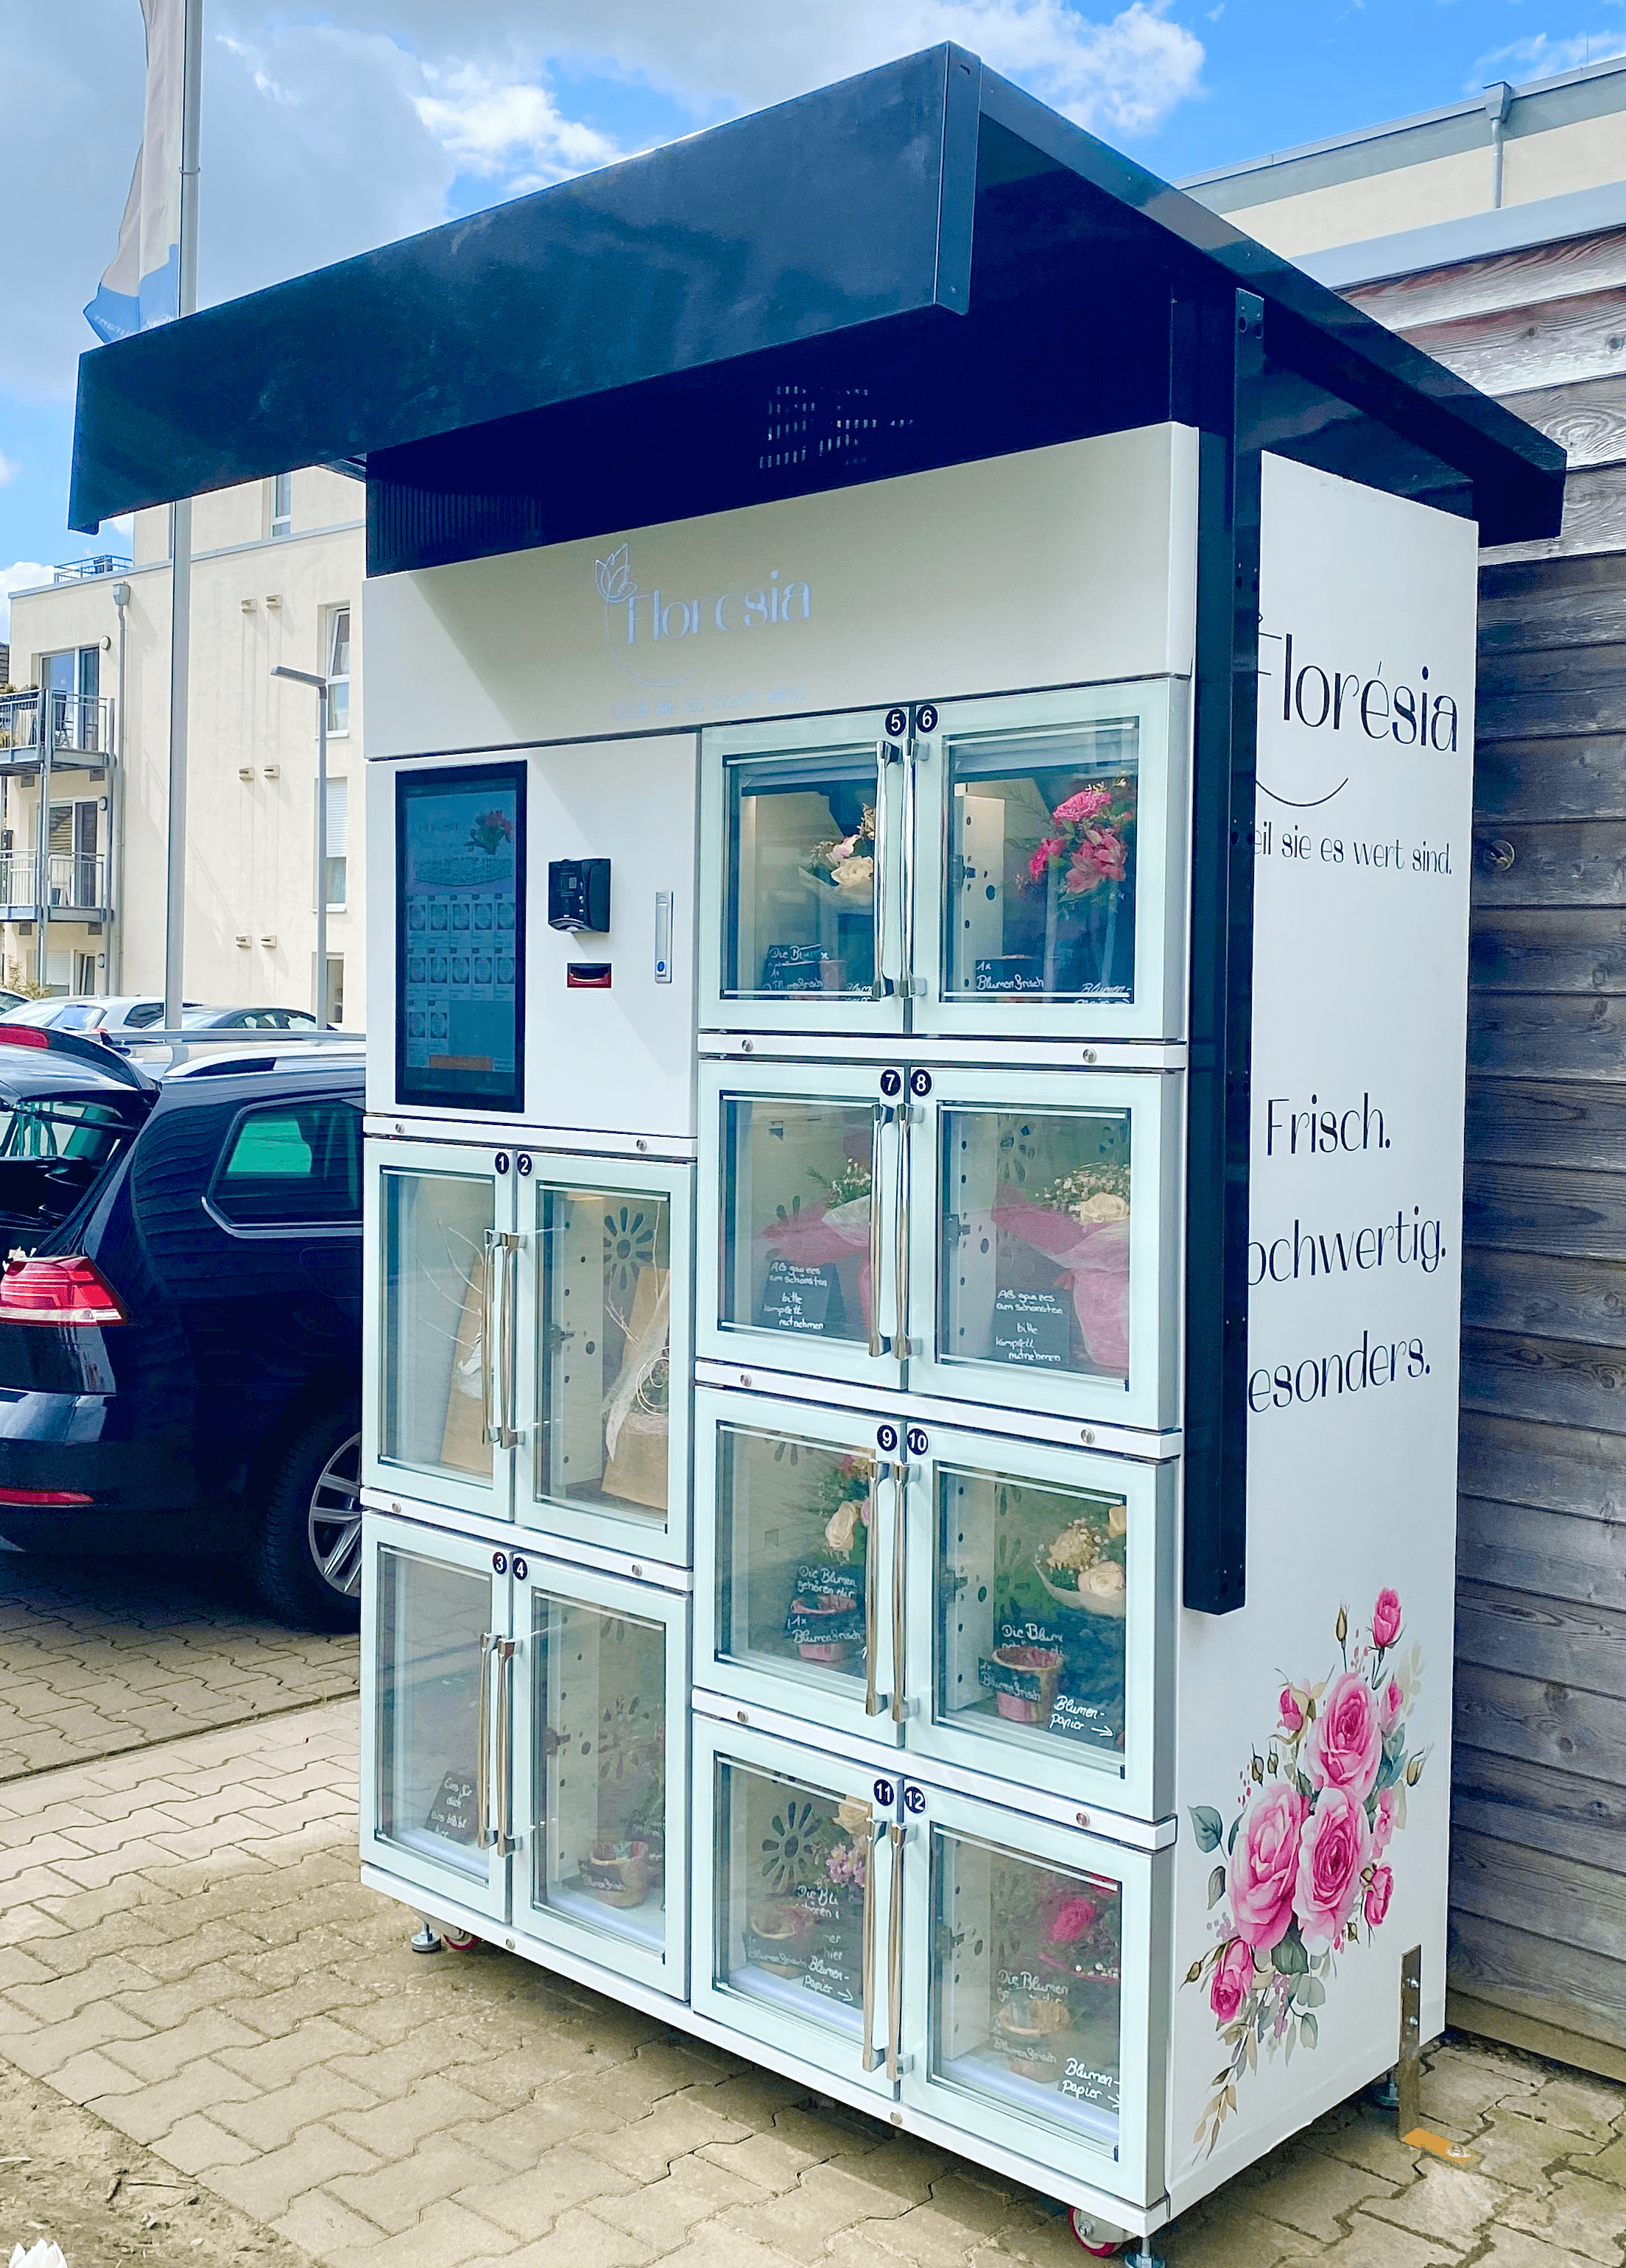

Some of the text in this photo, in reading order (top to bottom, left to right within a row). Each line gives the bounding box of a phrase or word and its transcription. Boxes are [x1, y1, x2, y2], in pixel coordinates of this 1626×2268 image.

[891, 713, 901, 731] 5
[922, 709, 932, 728] 6
[1255, 821, 1452, 876] eil sie es wert sind.
[885, 1074, 895, 1091] 7
[916, 1074, 926, 1092] 8
[1267, 1092, 1390, 1156] Frisch.
[521, 1157, 529, 1173] 2
[1247, 1205, 1447, 1286] ochwertig.
[1247, 1330, 1431, 1413] esonders.
[882, 1429, 893, 1448] 9
[909, 1431, 927, 1451] 10
[496, 1555, 504, 1571] 3
[516, 1561, 524, 1577] 4
[1002, 1624, 1024, 1638] Die
[1053, 1695, 1105, 1719] Blumen-
[876, 1783, 890, 1803] 11
[906, 1790, 924, 1811] 12
[1064, 2057, 1119, 2087] Blumen-
